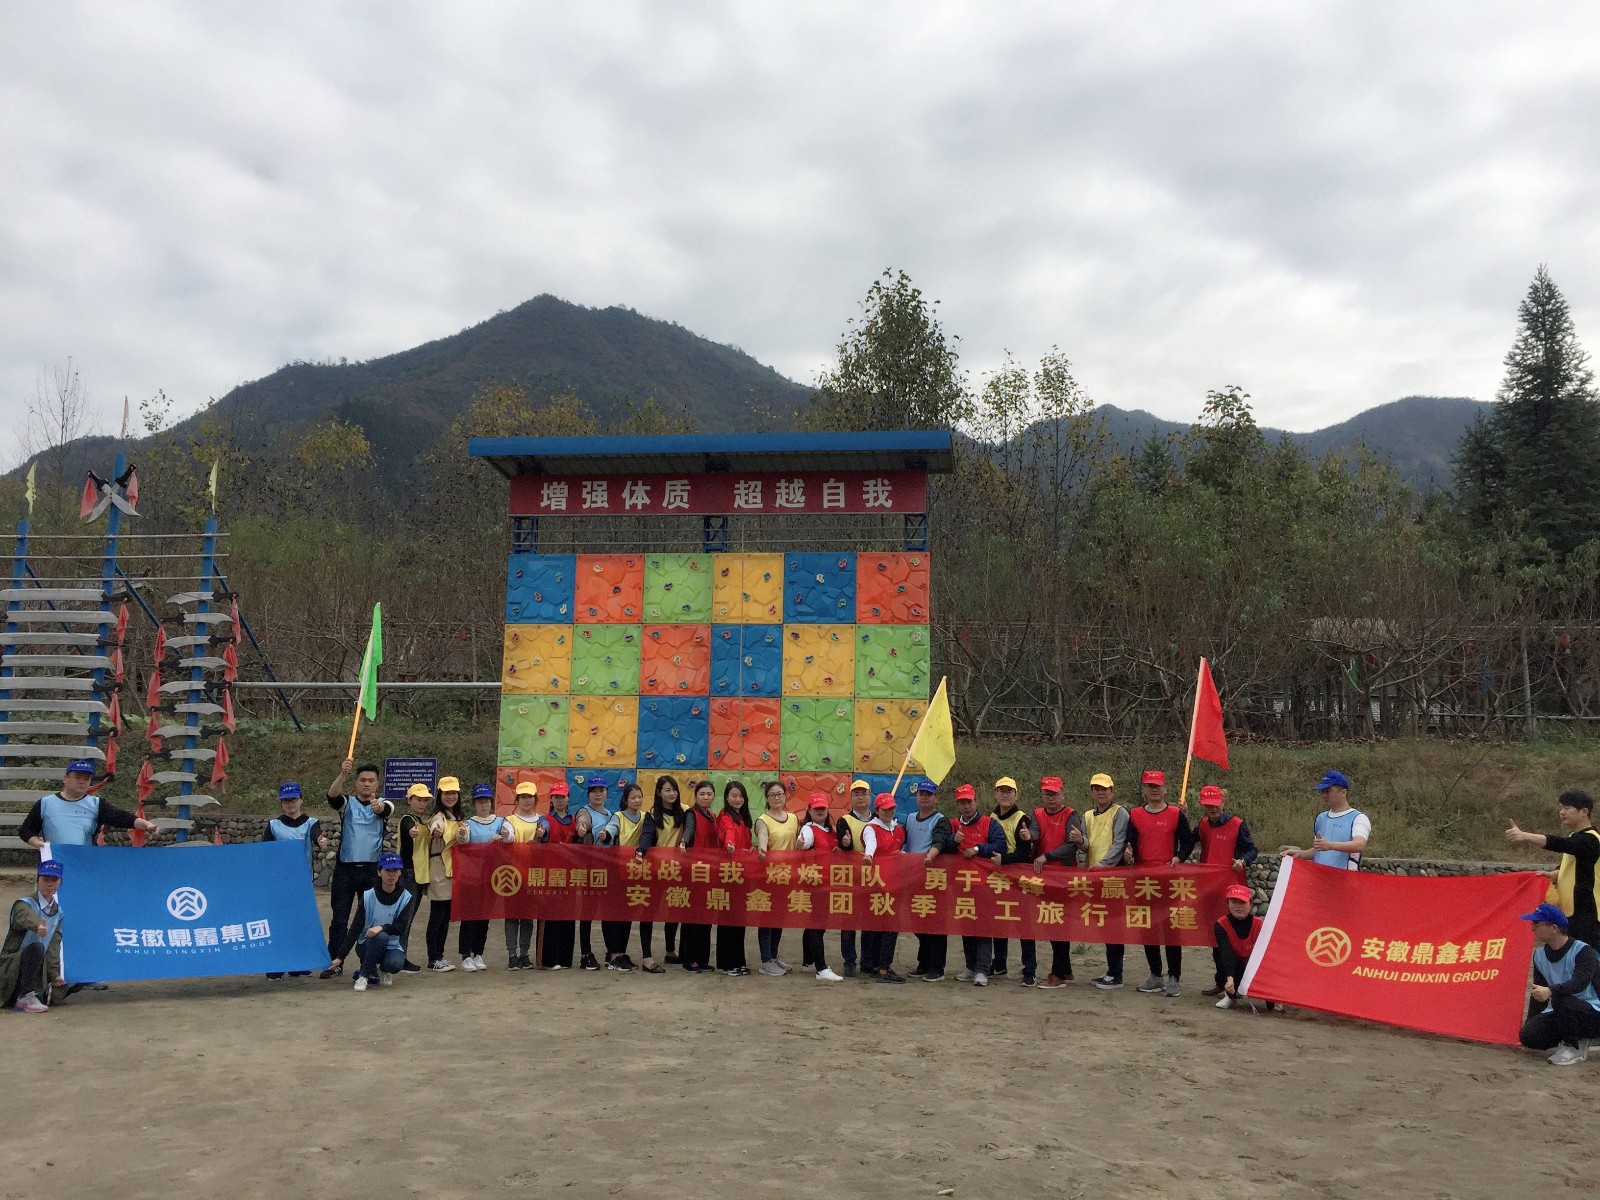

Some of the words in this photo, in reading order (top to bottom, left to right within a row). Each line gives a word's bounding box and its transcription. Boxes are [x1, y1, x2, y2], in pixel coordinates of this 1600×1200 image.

[541, 479, 691, 510] 增强体质
[733, 478, 893, 509] 超越自我
[527, 867, 608, 887] 鼎鑫集团
[627, 858, 745, 884] 挑战自我
[766, 863, 887, 888] 熔炼团队
[925, 867, 1045, 896] 勇于争锋
[1068, 875, 1197, 901] 共赢未来
[626, 884, 1198, 930] 安徽鼎鑫集团秋季员工旅行团建
[113, 919, 271, 948] 安徽鼎鑫集团
[166, 947, 221, 955] DINGXIN
[232, 940, 273, 951] GROUP
[1360, 937, 1507, 965] 安徽鼎鑫集团
[1352, 966, 1398, 982] ANHUI
[1400, 969, 1450, 983] DINXIN
[1452, 969, 1499, 984] GROUP
